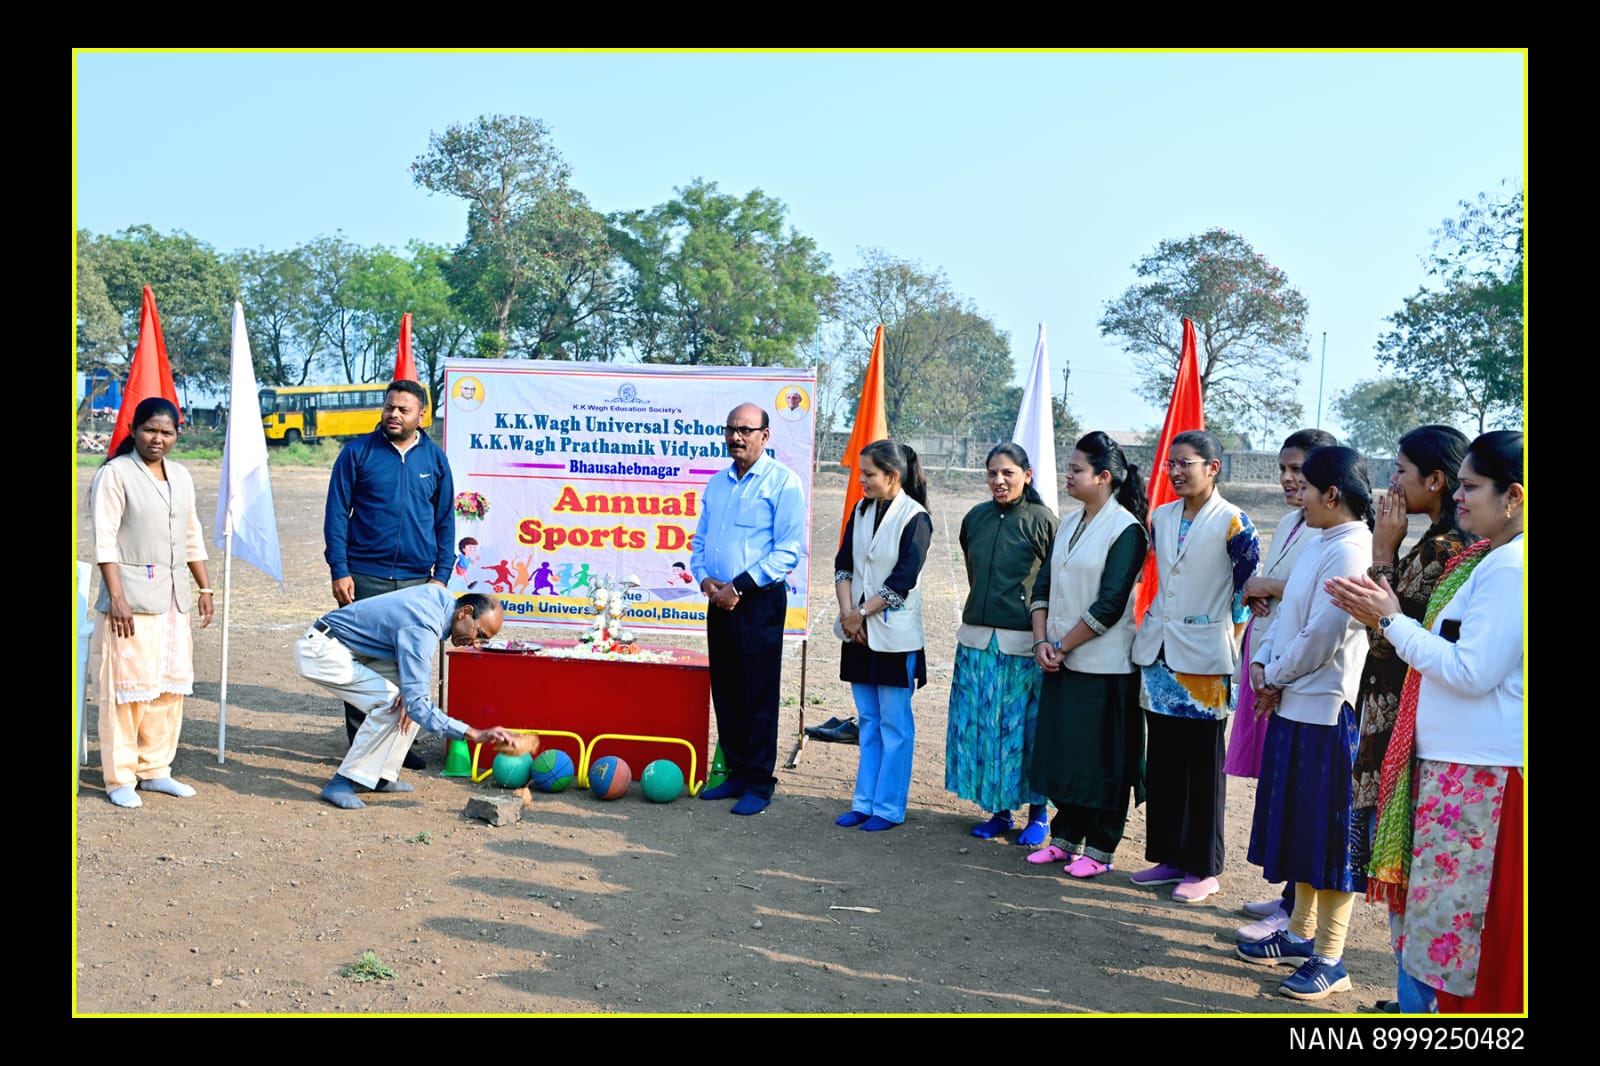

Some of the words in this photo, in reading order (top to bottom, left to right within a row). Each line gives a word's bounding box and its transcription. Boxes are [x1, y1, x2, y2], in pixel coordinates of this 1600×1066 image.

[573, 404, 608, 412] K.K.Wagh
[648, 406, 682, 414] Society's
[495, 413, 581, 435] K.K.Wagh
[585, 415, 669, 435] Universal
[674, 418, 726, 436] Schoo
[470, 433, 556, 455] K.K.Wagh
[560, 437, 656, 456] Prathamik
[569, 459, 680, 479] Bhausahebnagar
[553, 486, 697, 516] Annual
[518, 519, 646, 551] Sports
[539, 602, 591, 615] Univers
